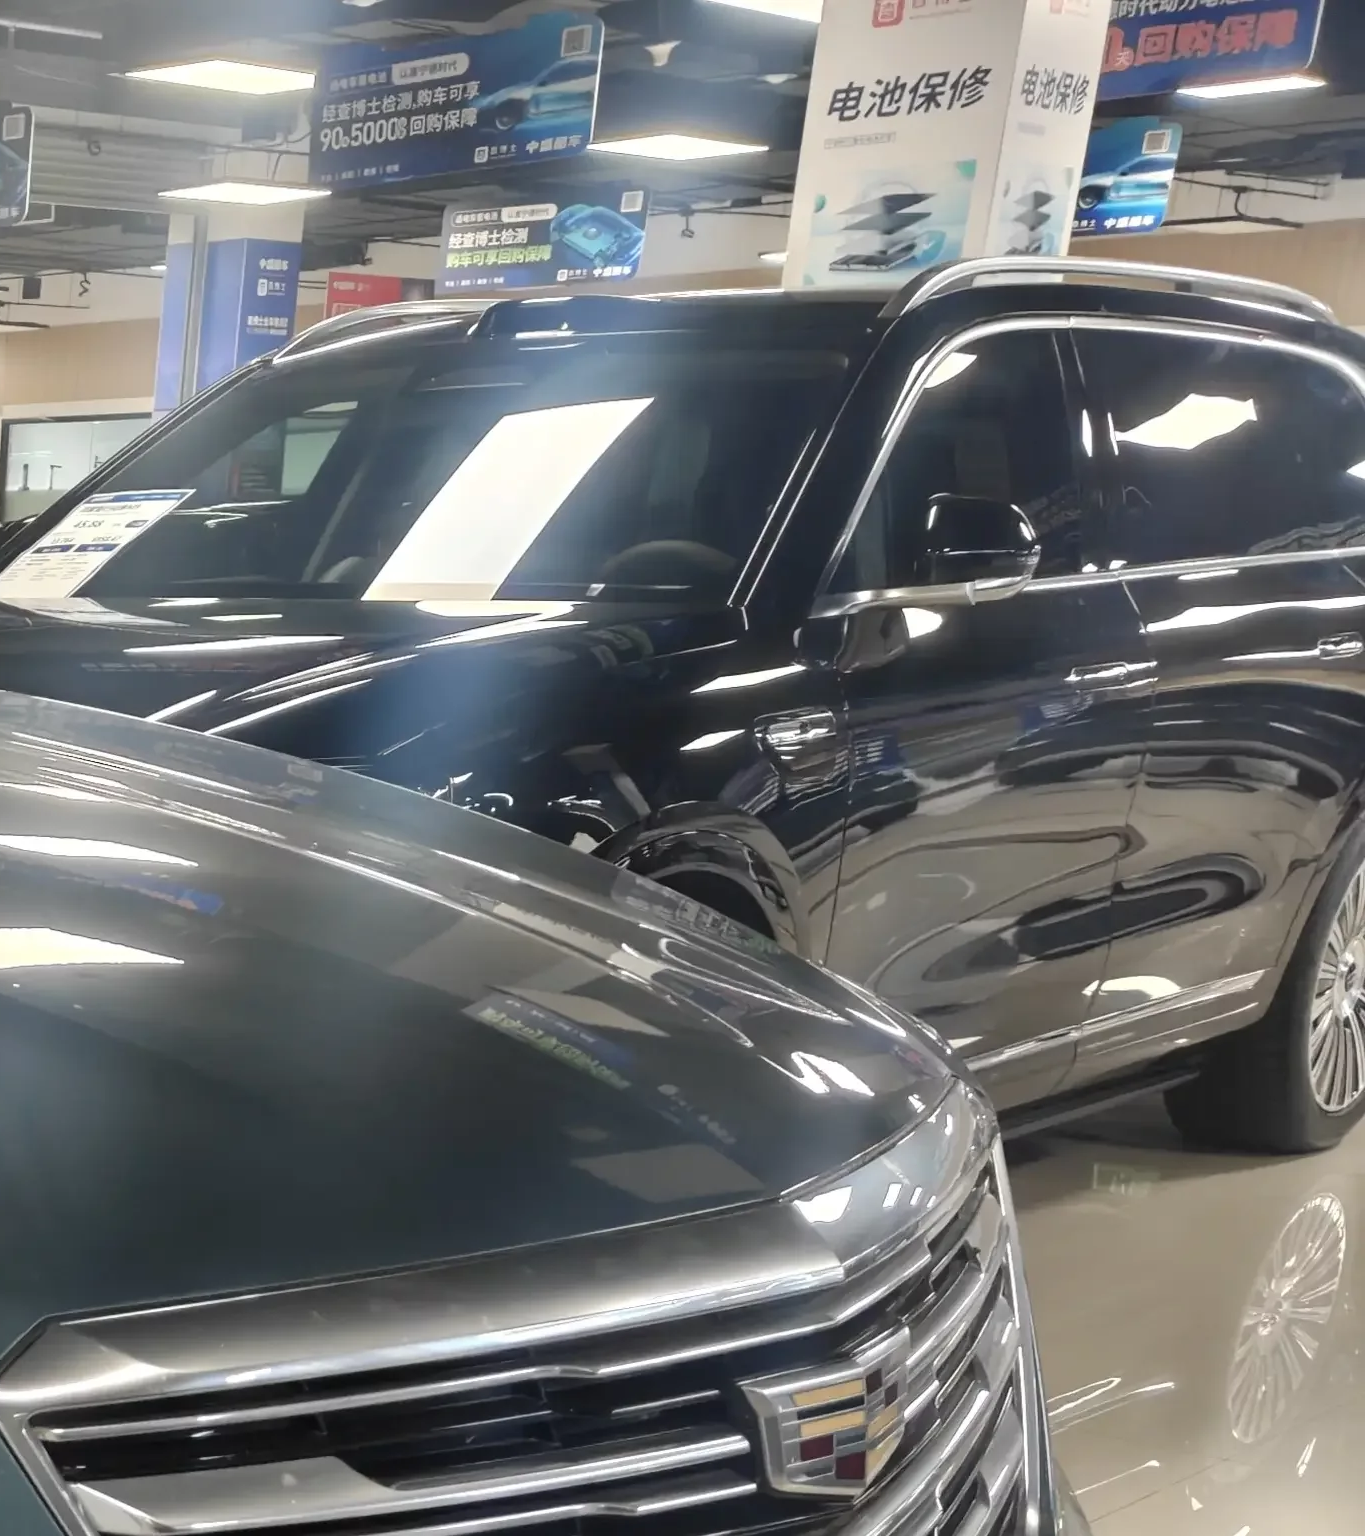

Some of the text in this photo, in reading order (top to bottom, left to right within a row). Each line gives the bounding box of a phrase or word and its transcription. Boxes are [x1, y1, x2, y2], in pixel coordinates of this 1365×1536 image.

[827, 65, 993, 122] 电池保修
[1021, 63, 1090, 115] 电池保修
